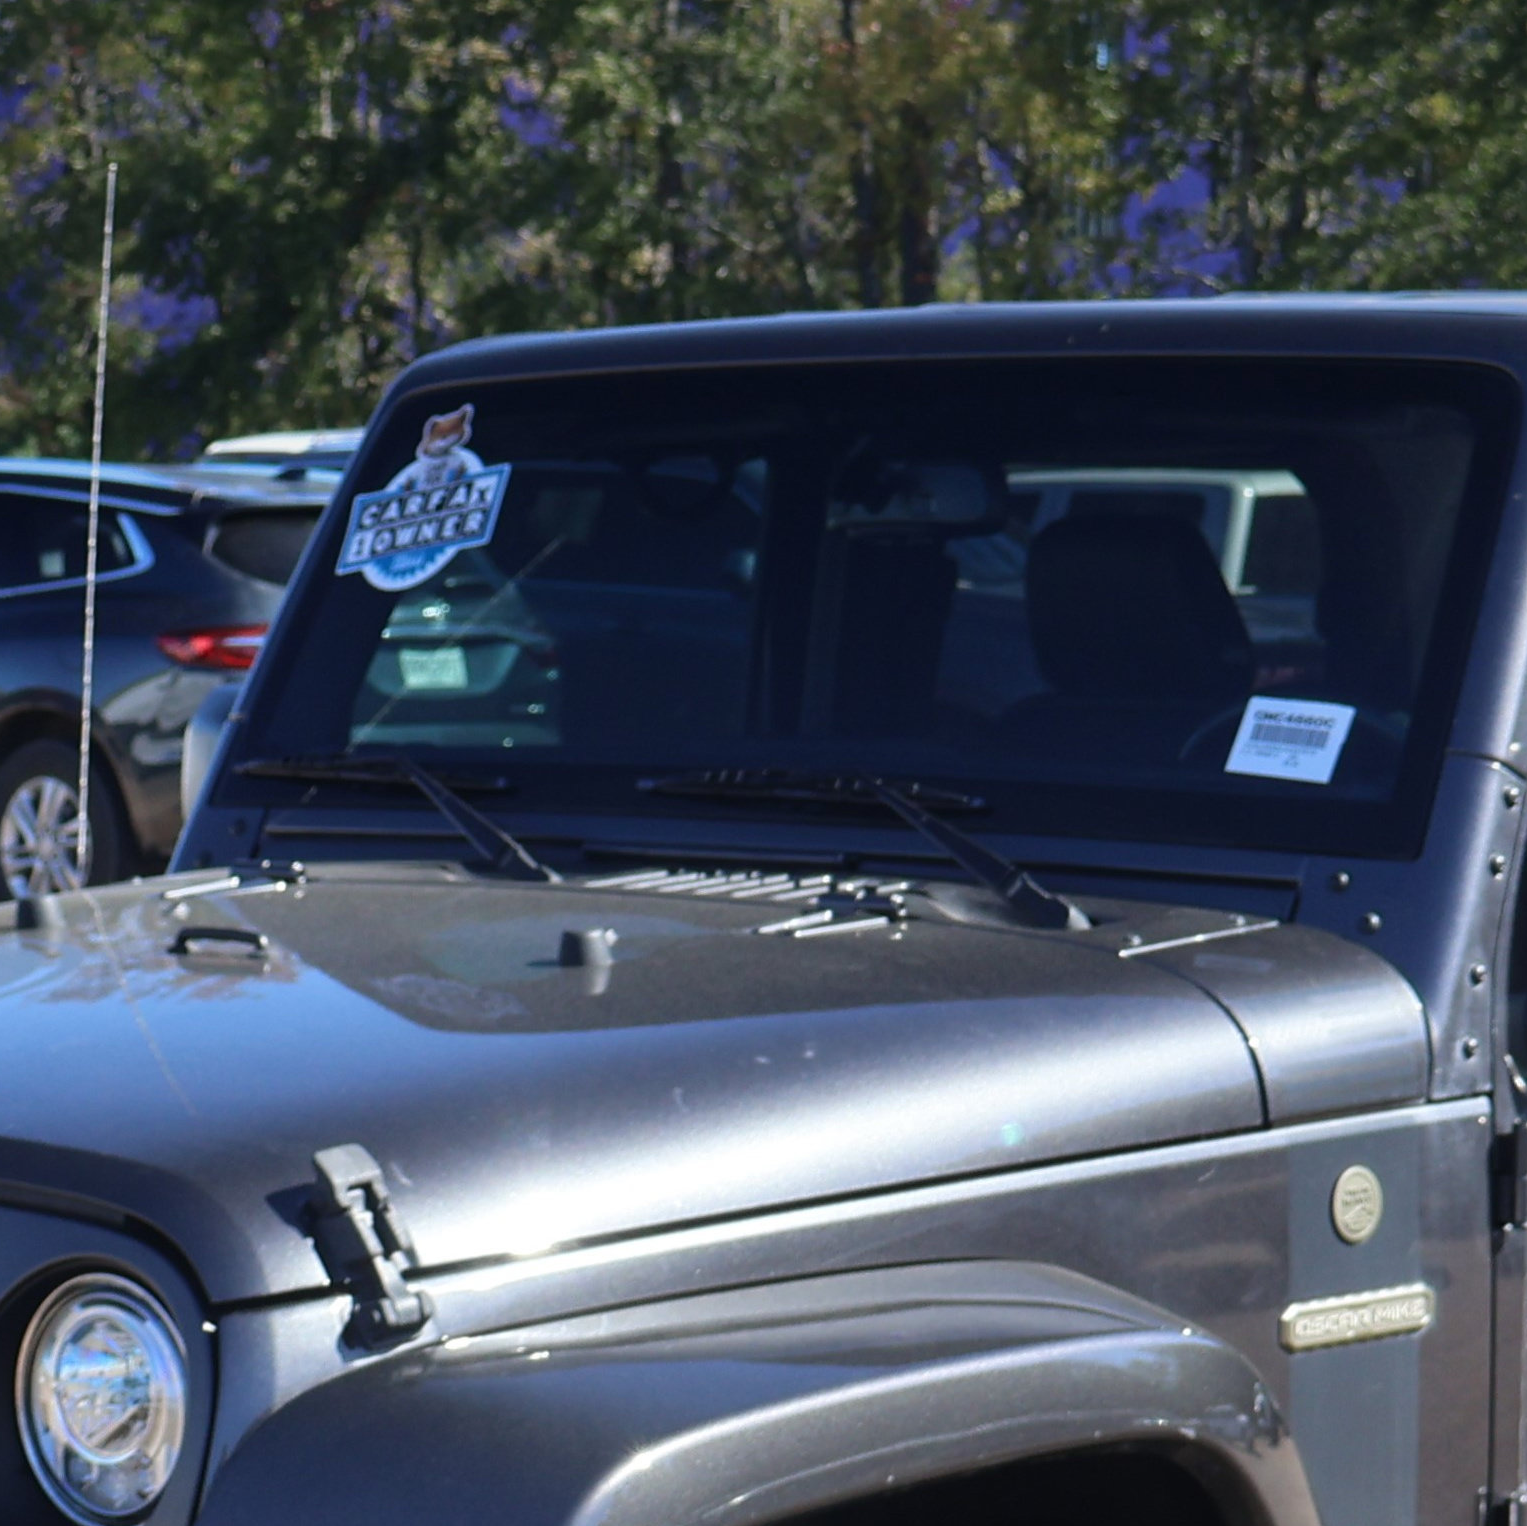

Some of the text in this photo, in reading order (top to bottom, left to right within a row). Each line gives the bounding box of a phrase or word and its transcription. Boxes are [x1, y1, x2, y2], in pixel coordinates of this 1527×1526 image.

[362, 479, 495, 527] CARFAX
[372, 511, 484, 553] OWNER
[1297, 1296, 1427, 1336] OSCAR MIKE
